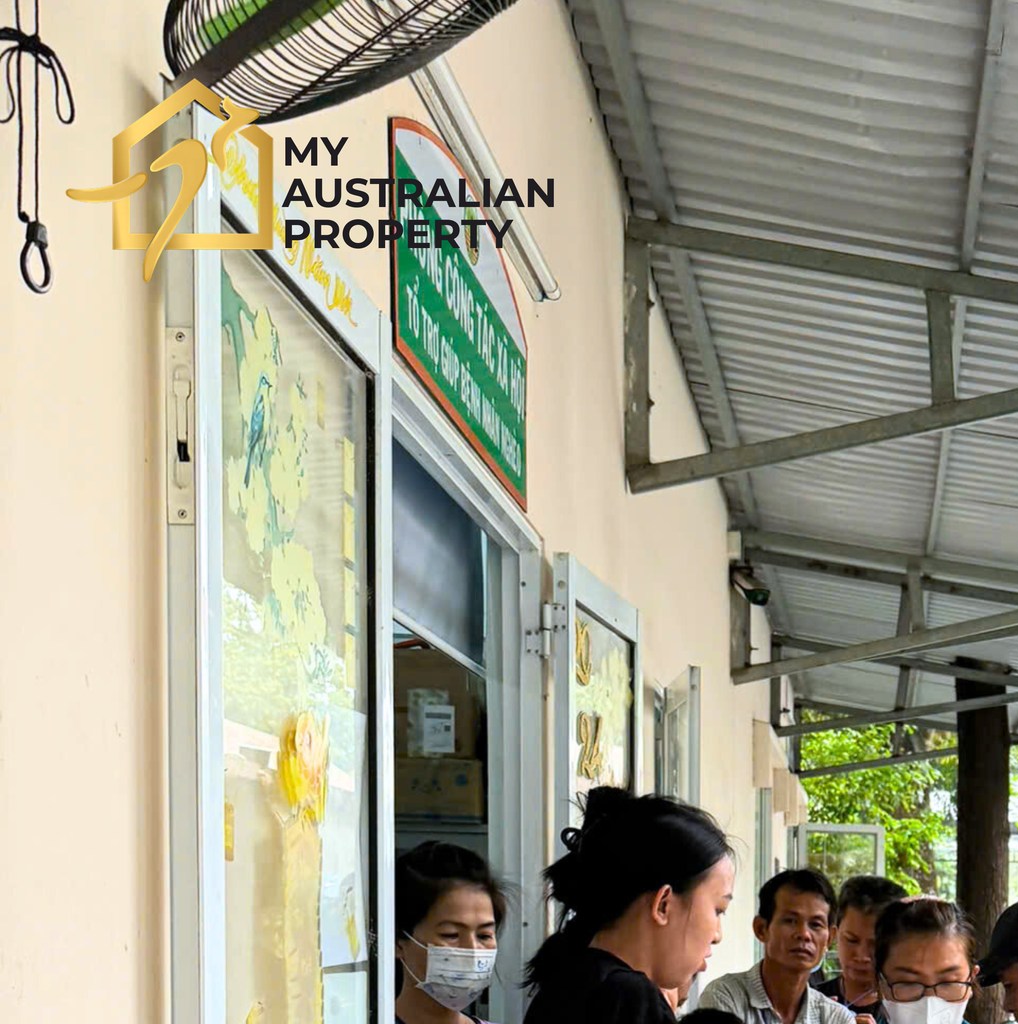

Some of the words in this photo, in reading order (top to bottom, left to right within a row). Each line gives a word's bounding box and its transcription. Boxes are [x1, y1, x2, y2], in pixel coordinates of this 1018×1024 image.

[406, 275, 420, 339] TỔ
[445, 252, 475, 345] CÔNG
[476, 302, 496, 374] TÁC
[497, 335, 509, 396] XÃ
